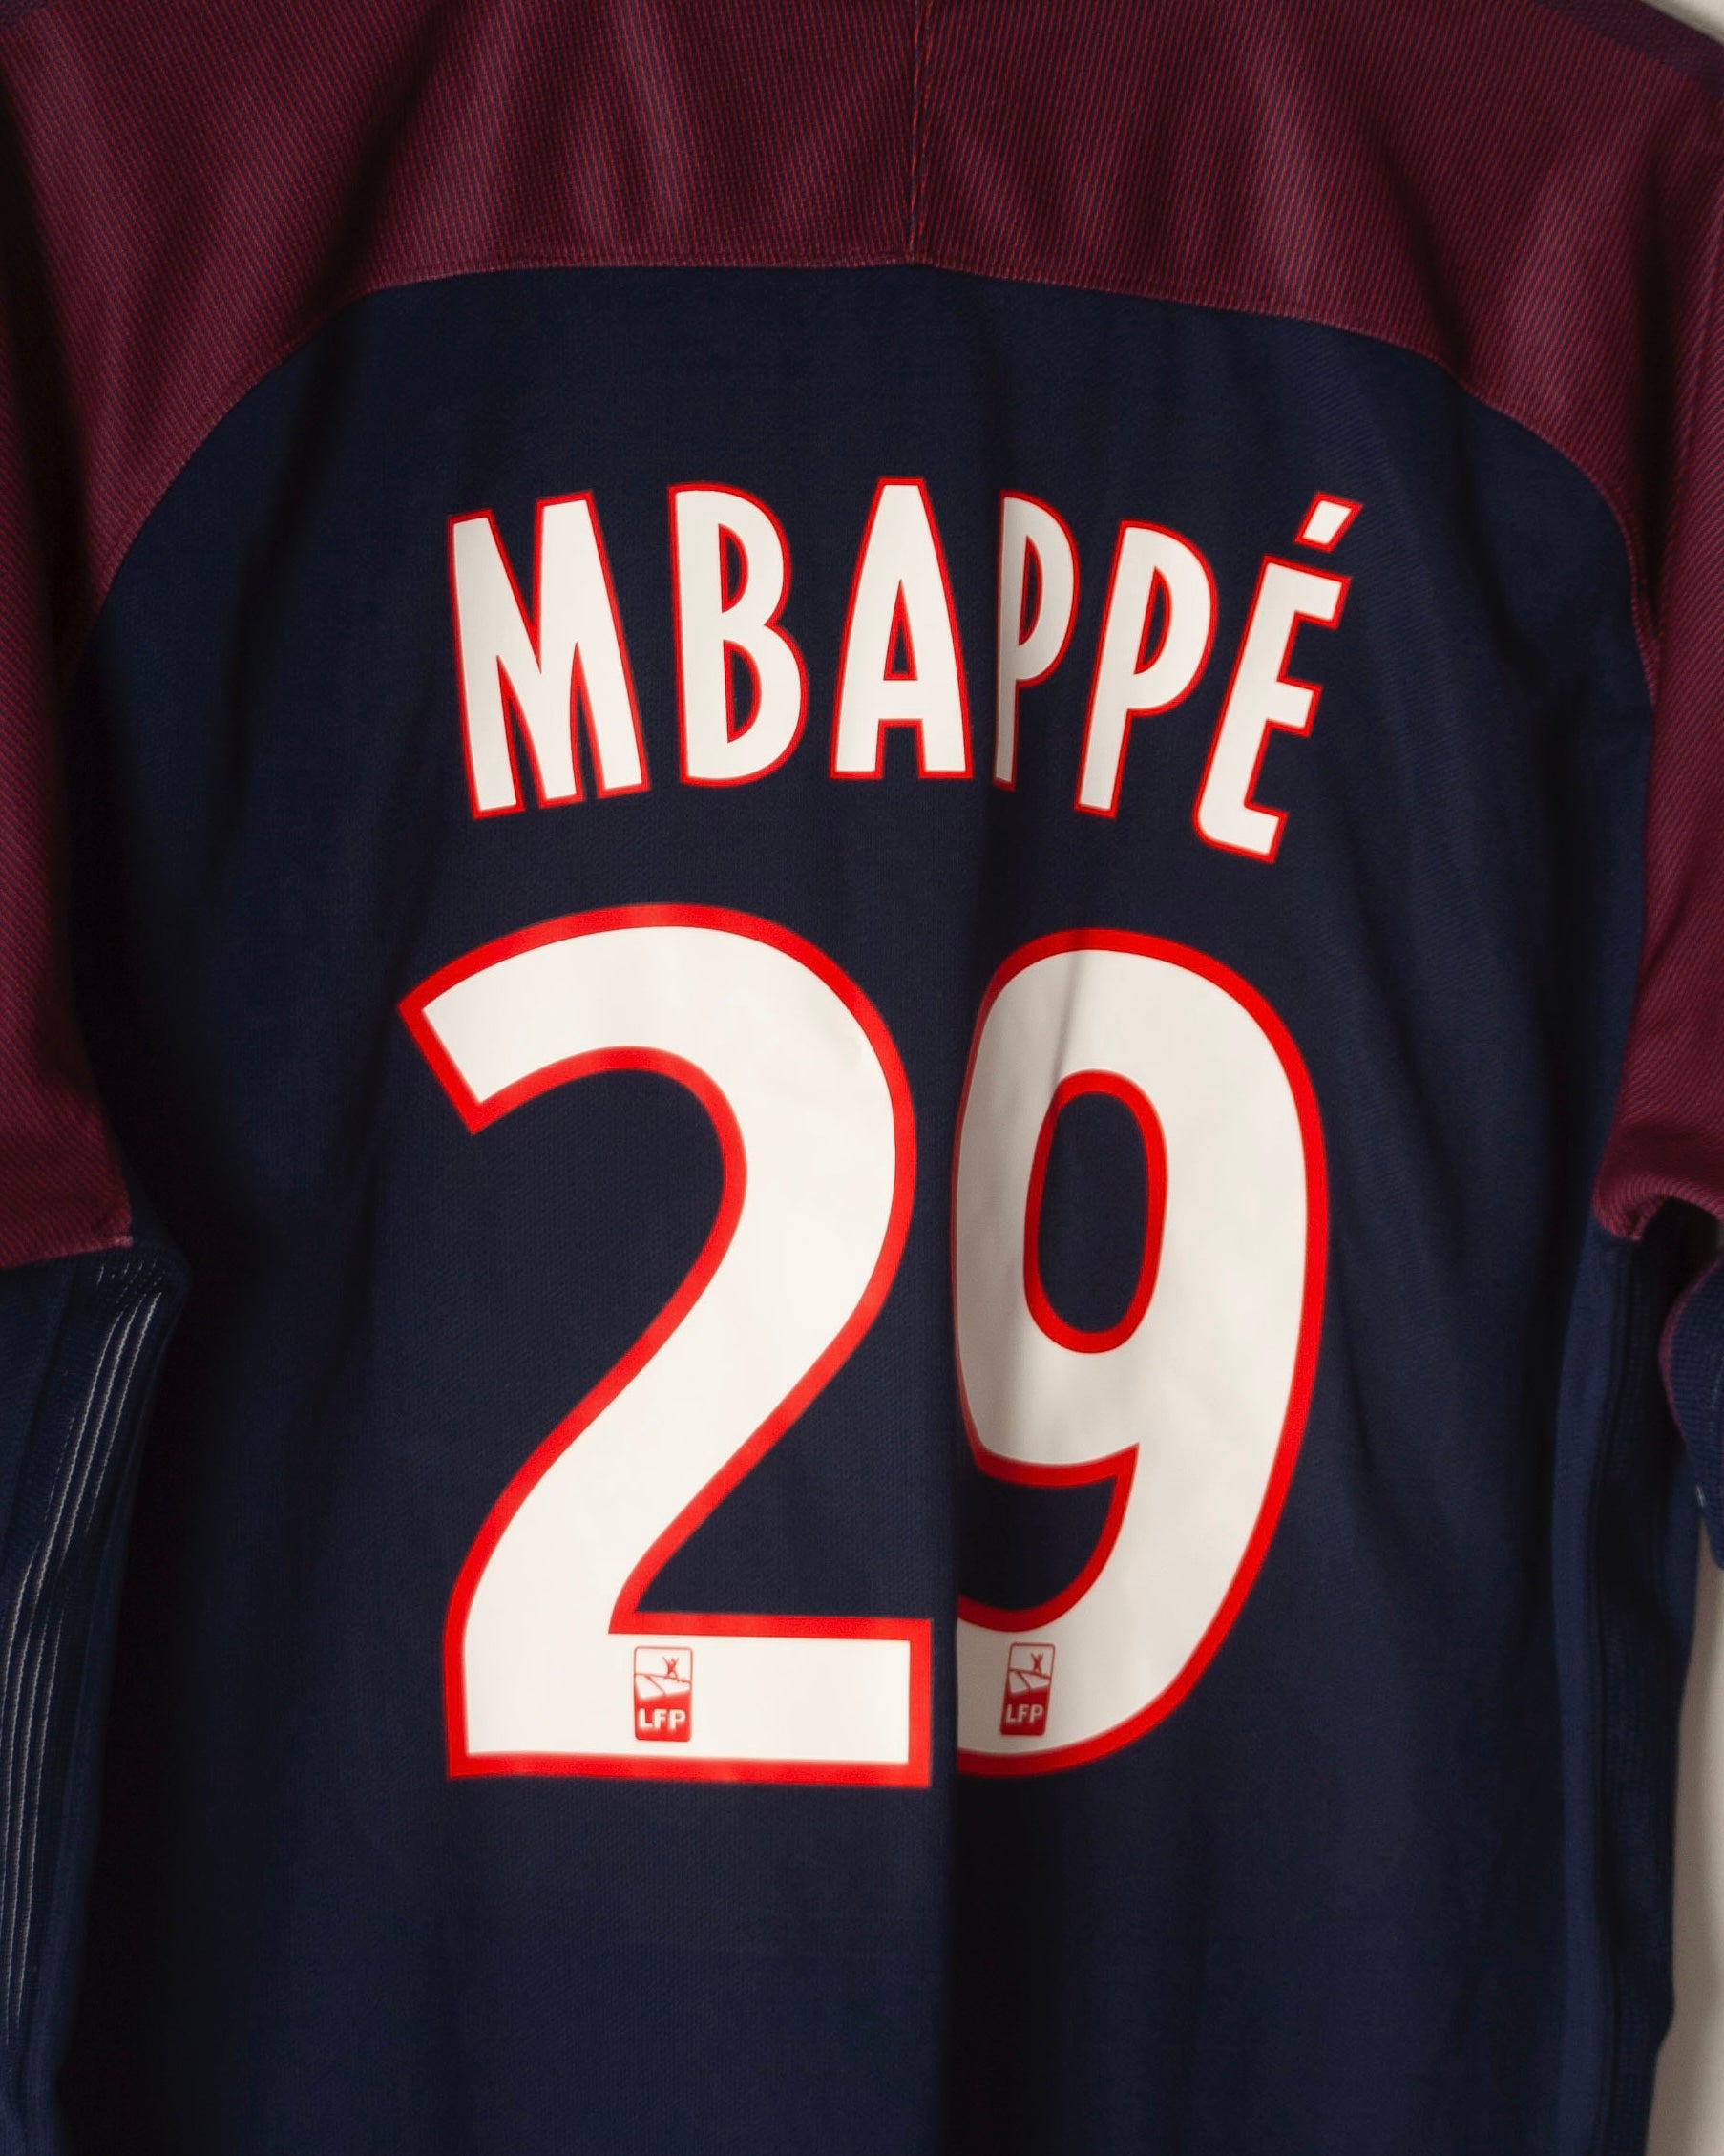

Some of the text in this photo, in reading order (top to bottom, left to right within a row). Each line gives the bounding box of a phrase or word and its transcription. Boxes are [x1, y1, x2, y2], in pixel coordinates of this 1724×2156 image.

[447, 476, 1363, 864] MBAPPÉ
[398, 902, 1330, 1789] 29
[638, 1707, 686, 1730] LFP
[1005, 1703, 1044, 1724] LFP
